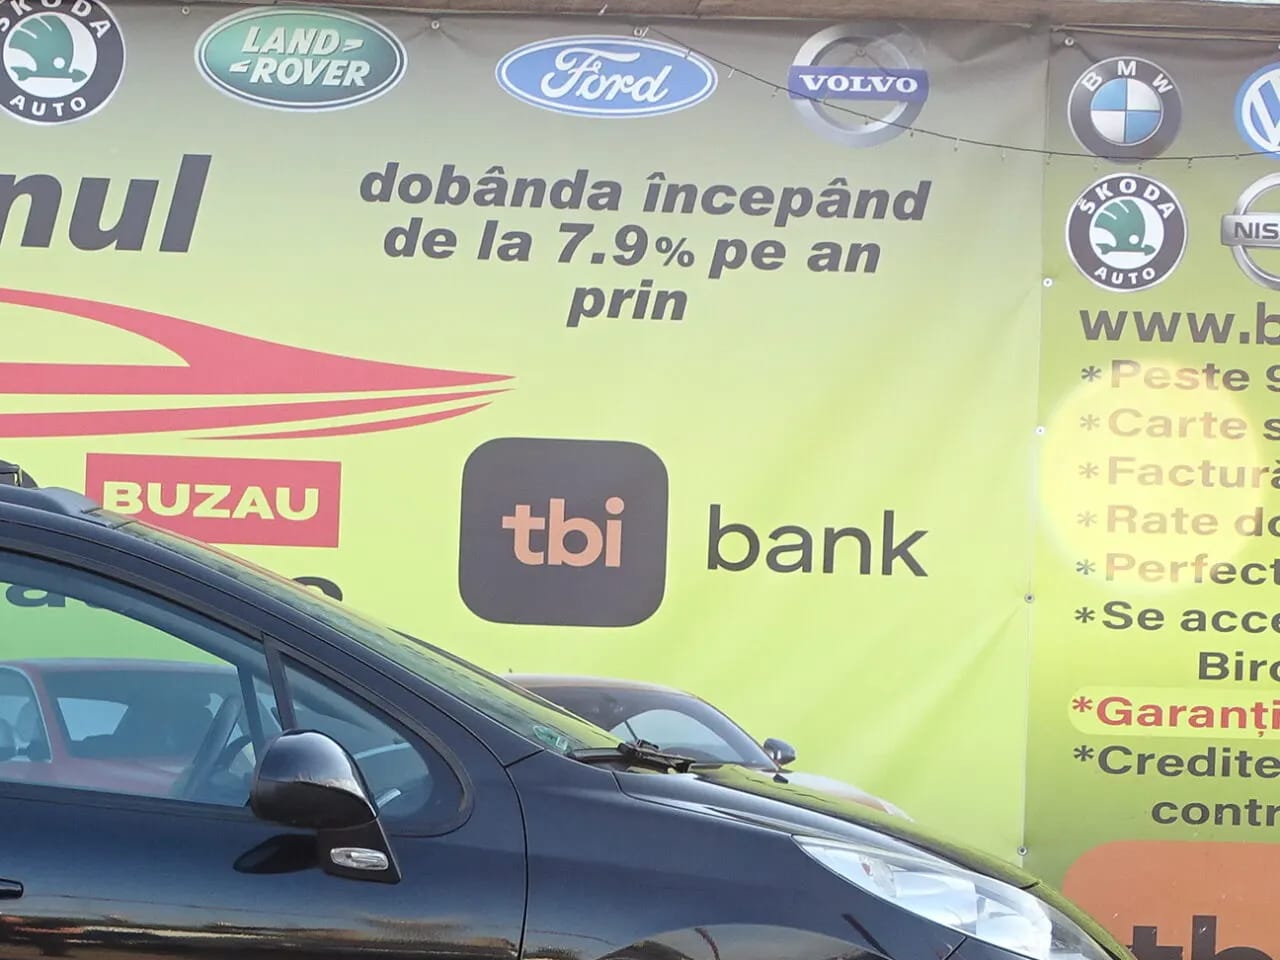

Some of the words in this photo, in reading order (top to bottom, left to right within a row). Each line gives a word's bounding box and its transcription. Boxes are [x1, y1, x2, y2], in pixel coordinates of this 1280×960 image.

[240, 26, 342, 56] LAND
[249, 57, 370, 87] ROVER
[539, 47, 670, 104] Ford
[799, 73, 918, 96] VOLVO
[1081, 61, 1173, 94] BMW
[9, 95, 86, 116] AUTO
[359, 162, 622, 211] dobânda
[643, 173, 931, 228] începând
[1077, 177, 1176, 219] ŠKODA
[383, 217, 458, 260] de
[476, 220, 533, 262] la
[557, 224, 695, 268] 7.9%
[708, 236, 787, 279] pe
[806, 238, 881, 274] an
[1094, 266, 1156, 285] AUTO
[566, 279, 688, 328] prin
[103, 481, 320, 521] BUZAU
[501, 496, 625, 567] tbi
[707, 503, 929, 577] bank
